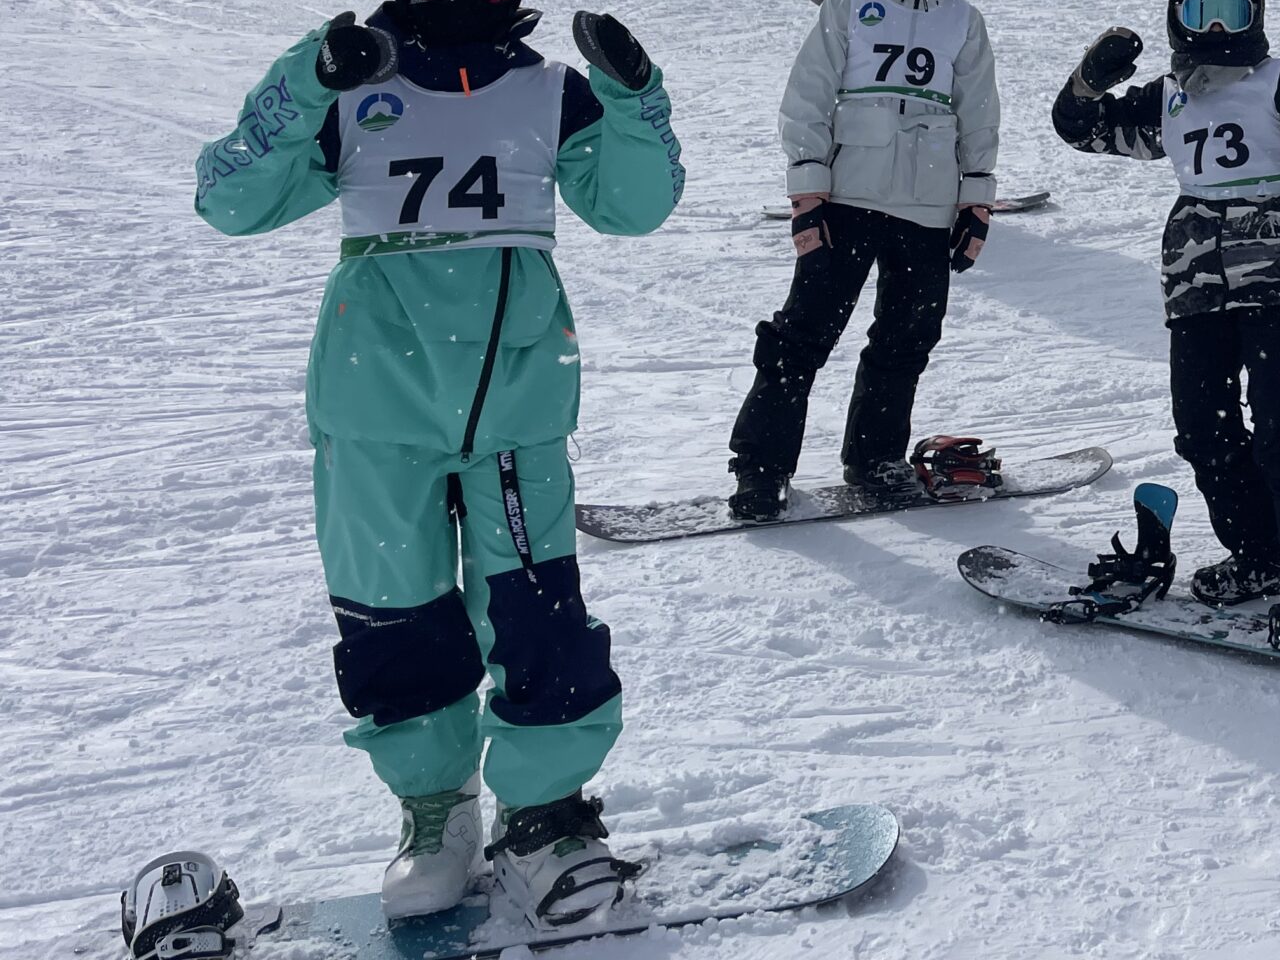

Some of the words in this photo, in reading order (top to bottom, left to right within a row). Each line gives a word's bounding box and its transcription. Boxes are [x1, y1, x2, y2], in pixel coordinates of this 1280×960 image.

[872, 43, 936, 86] 79
[1183, 122, 1250, 176] 73
[387, 155, 506, 225] 74
